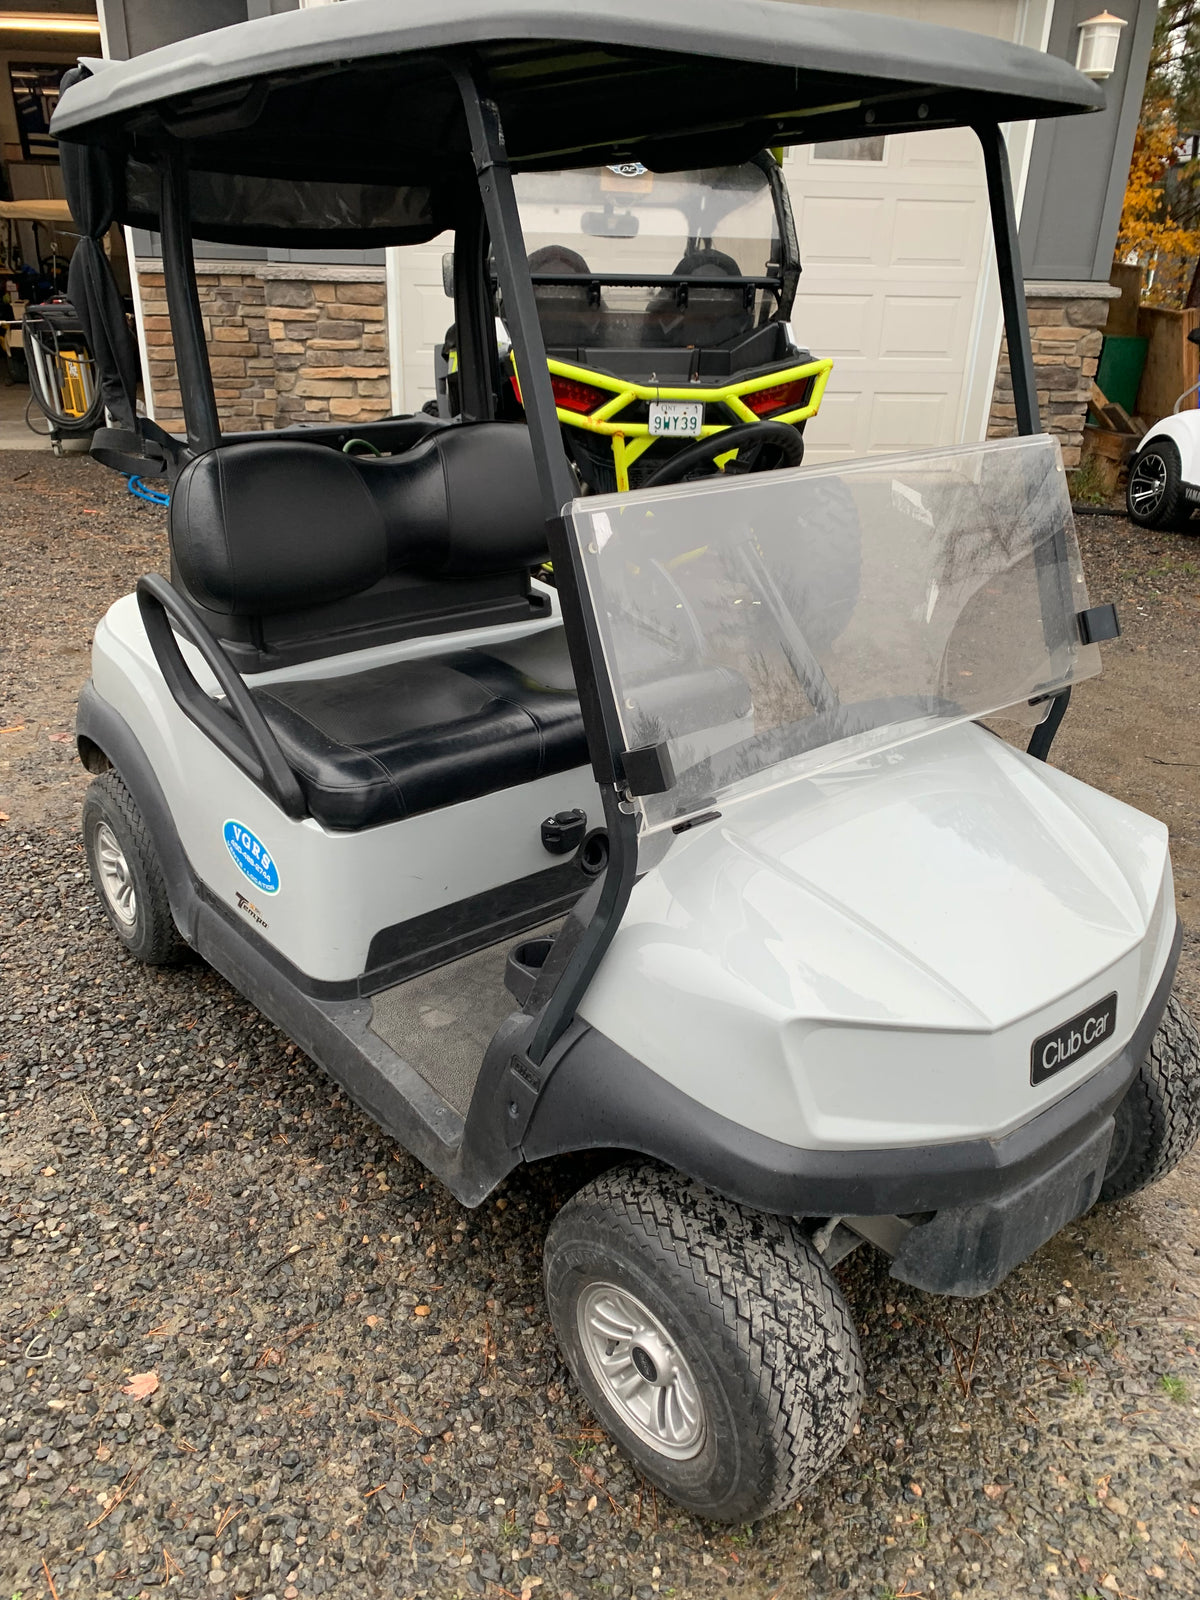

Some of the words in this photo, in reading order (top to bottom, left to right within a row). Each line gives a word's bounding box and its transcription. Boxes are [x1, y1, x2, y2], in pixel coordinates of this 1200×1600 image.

[654, 416, 697, 430] 9WY39
[232, 824, 271, 870] VGRS
[235, 891, 268, 928] Tempo
[1042, 1030, 1082, 1069] Club
[1083, 1012, 1110, 1045] Car
